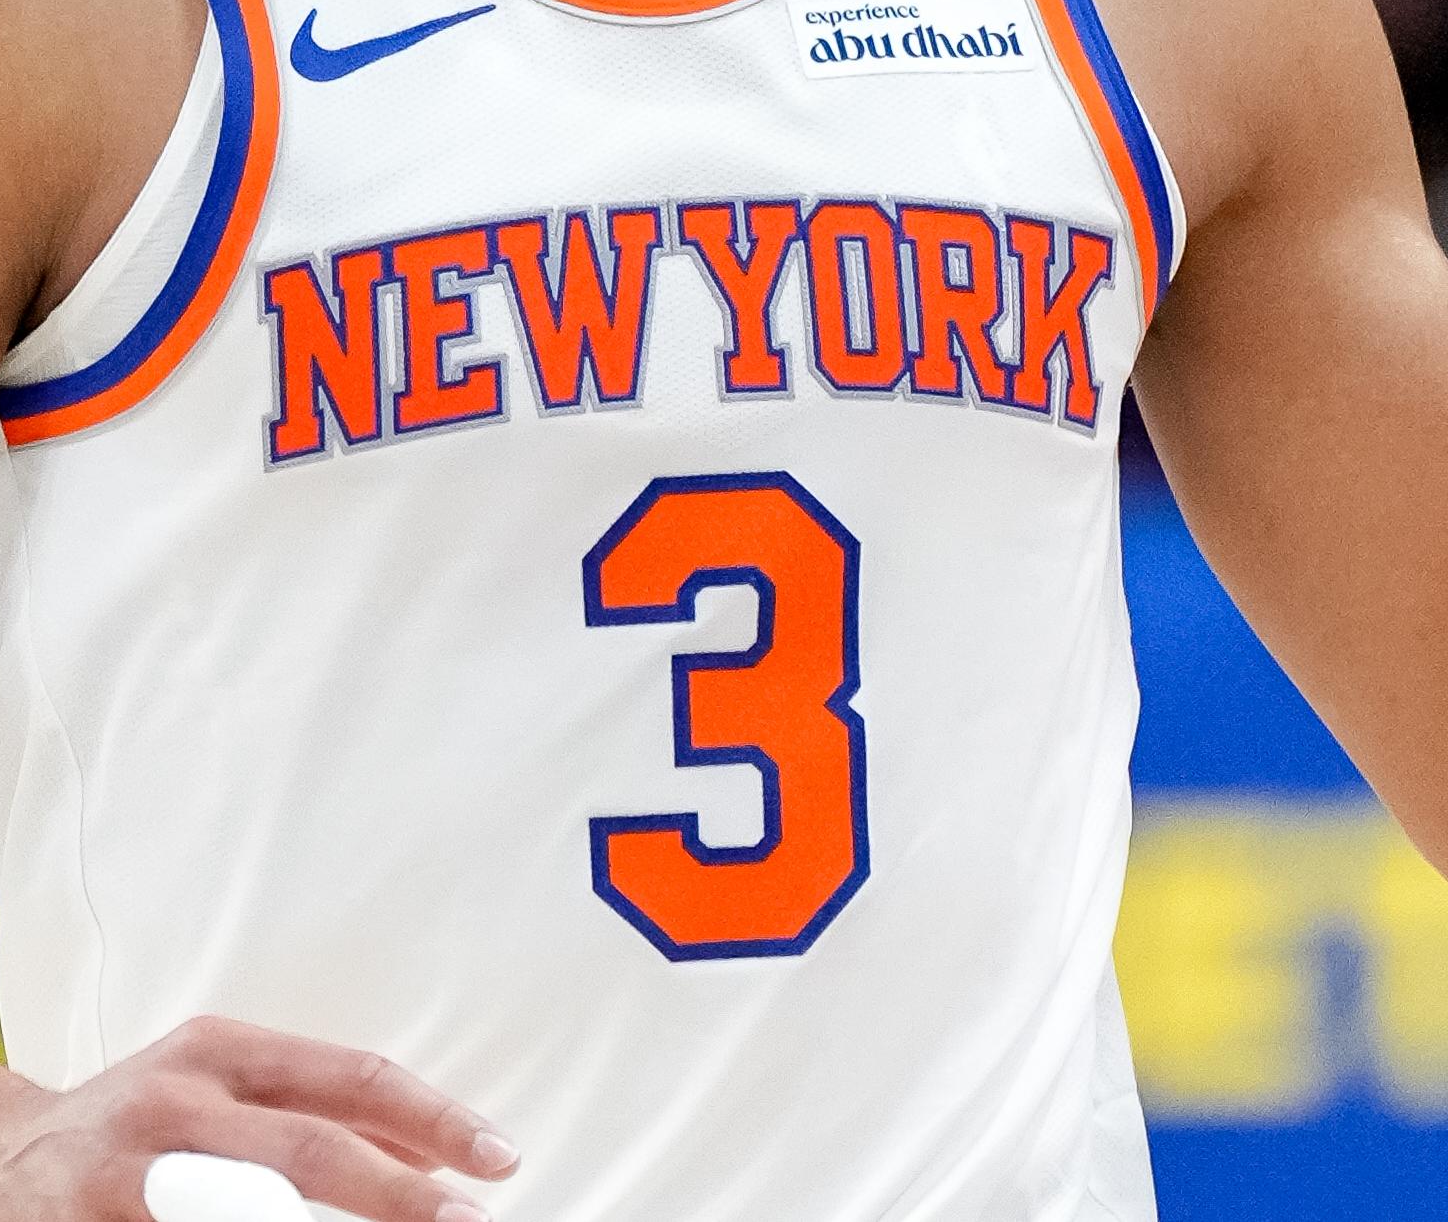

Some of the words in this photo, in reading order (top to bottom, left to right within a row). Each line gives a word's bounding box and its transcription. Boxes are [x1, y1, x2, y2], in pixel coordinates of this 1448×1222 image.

[805, 3, 920, 27] experience
[809, 28, 896, 64] abu
[261, 204, 665, 472] NEW
[676, 194, 1116, 438] YORK
[582, 470, 871, 963] 3
